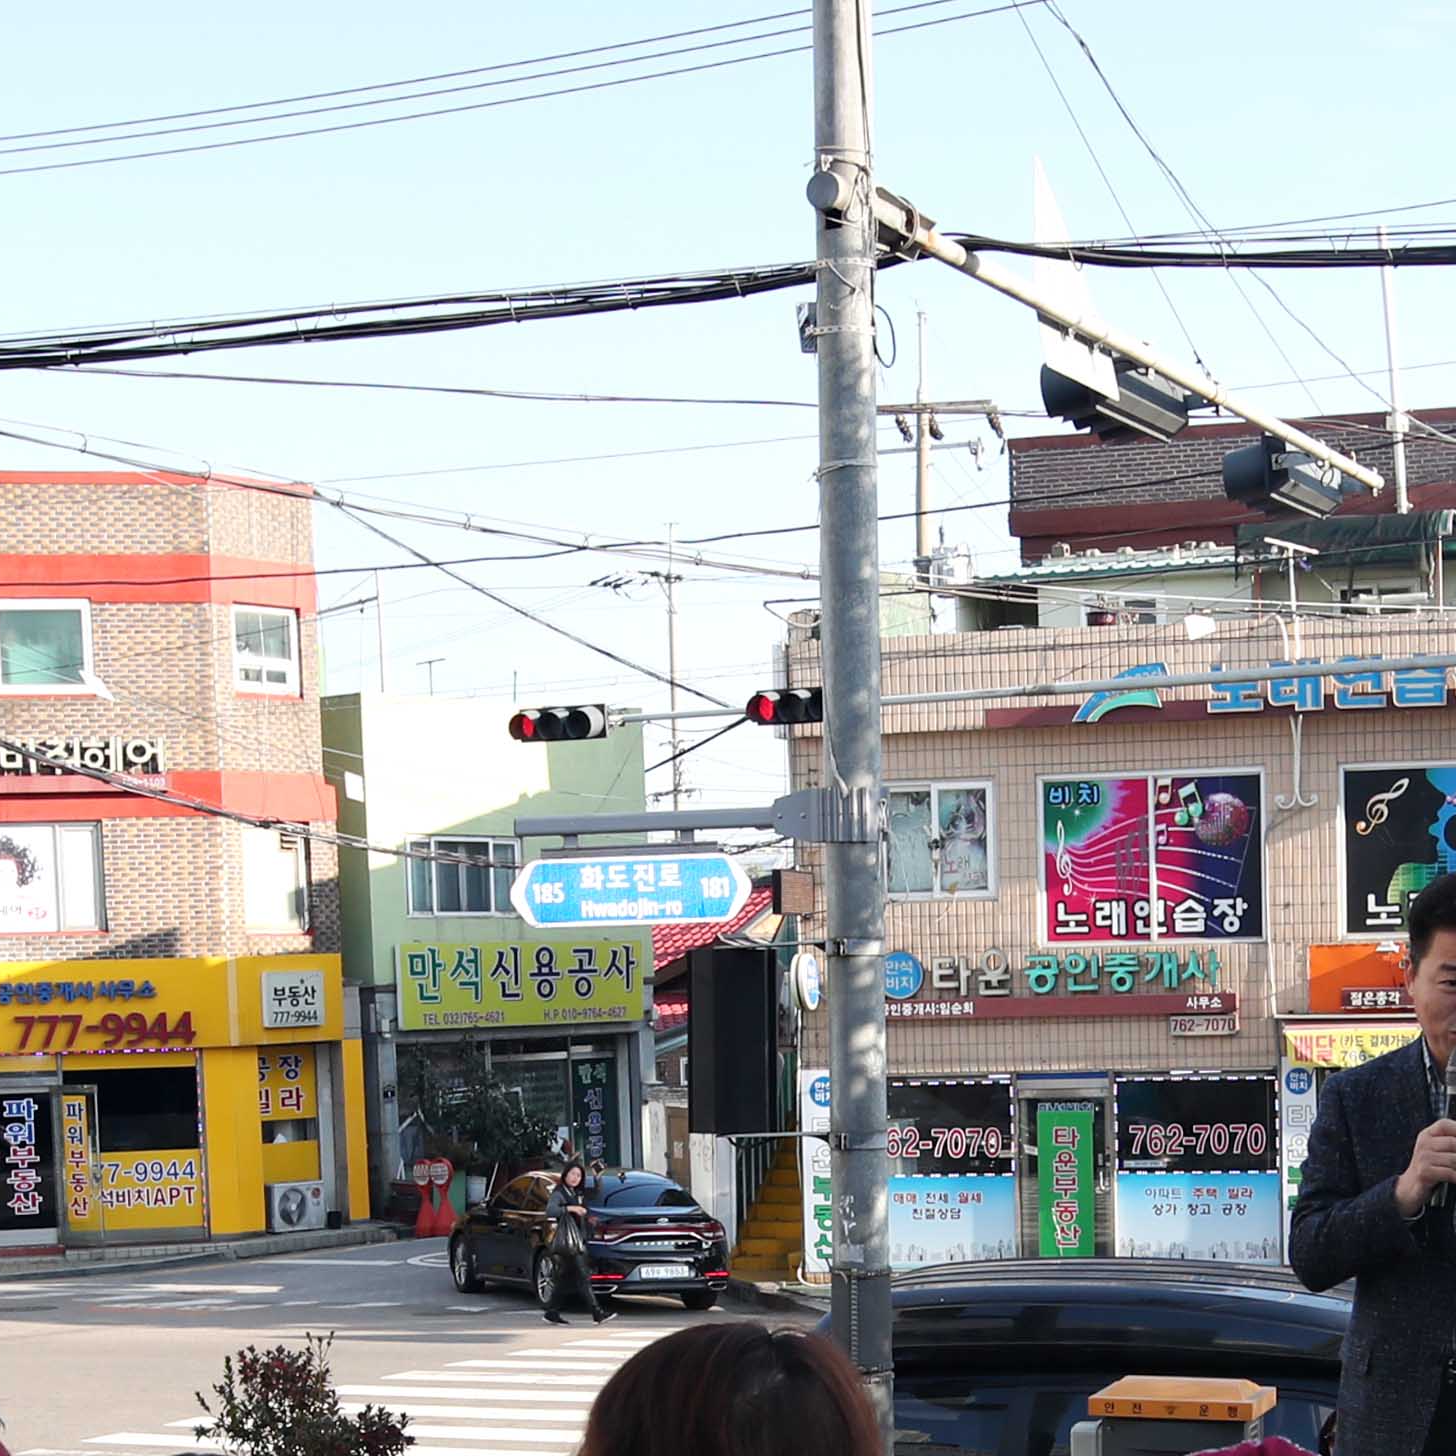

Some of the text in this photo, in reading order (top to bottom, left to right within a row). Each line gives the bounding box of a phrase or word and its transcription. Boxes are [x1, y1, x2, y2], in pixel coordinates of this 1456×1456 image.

[1049, 783, 1101, 806] 비치
[580, 864, 682, 892] 화도진로
[532, 876, 730, 919] 185 Hwadojin-ro 181
[1054, 897, 1248, 937] 노래연습장
[407, 945, 636, 1002] 만석신용공사
[932, 947, 1222, 996] 타운 공인중개사
[98, 979, 158, 1000] 사무소
[273, 985, 317, 1007] 부동산
[1350, 991, 1401, 1006] 젊은총각
[1186, 996, 1223, 1009] 사무소
[272, 1010, 318, 1024] 777-9944
[1170, 1017, 1236, 1032] 762-7070
[13, 1011, 197, 1049] 777-9944
[1294, 1034, 1336, 1062] 배달
[1128, 1123, 1267, 1157] 762-7070
[3, 1098, 43, 1216] 파워부동산
[65, 1101, 90, 1218] 파워부동산
[925, 1192, 949, 1205] 전세
[1145, 1187, 1254, 1200] 아파트 주택 빌라
[912, 1207, 962, 1220] 친절상담
[1152, 1204, 1177, 1216] 상가
